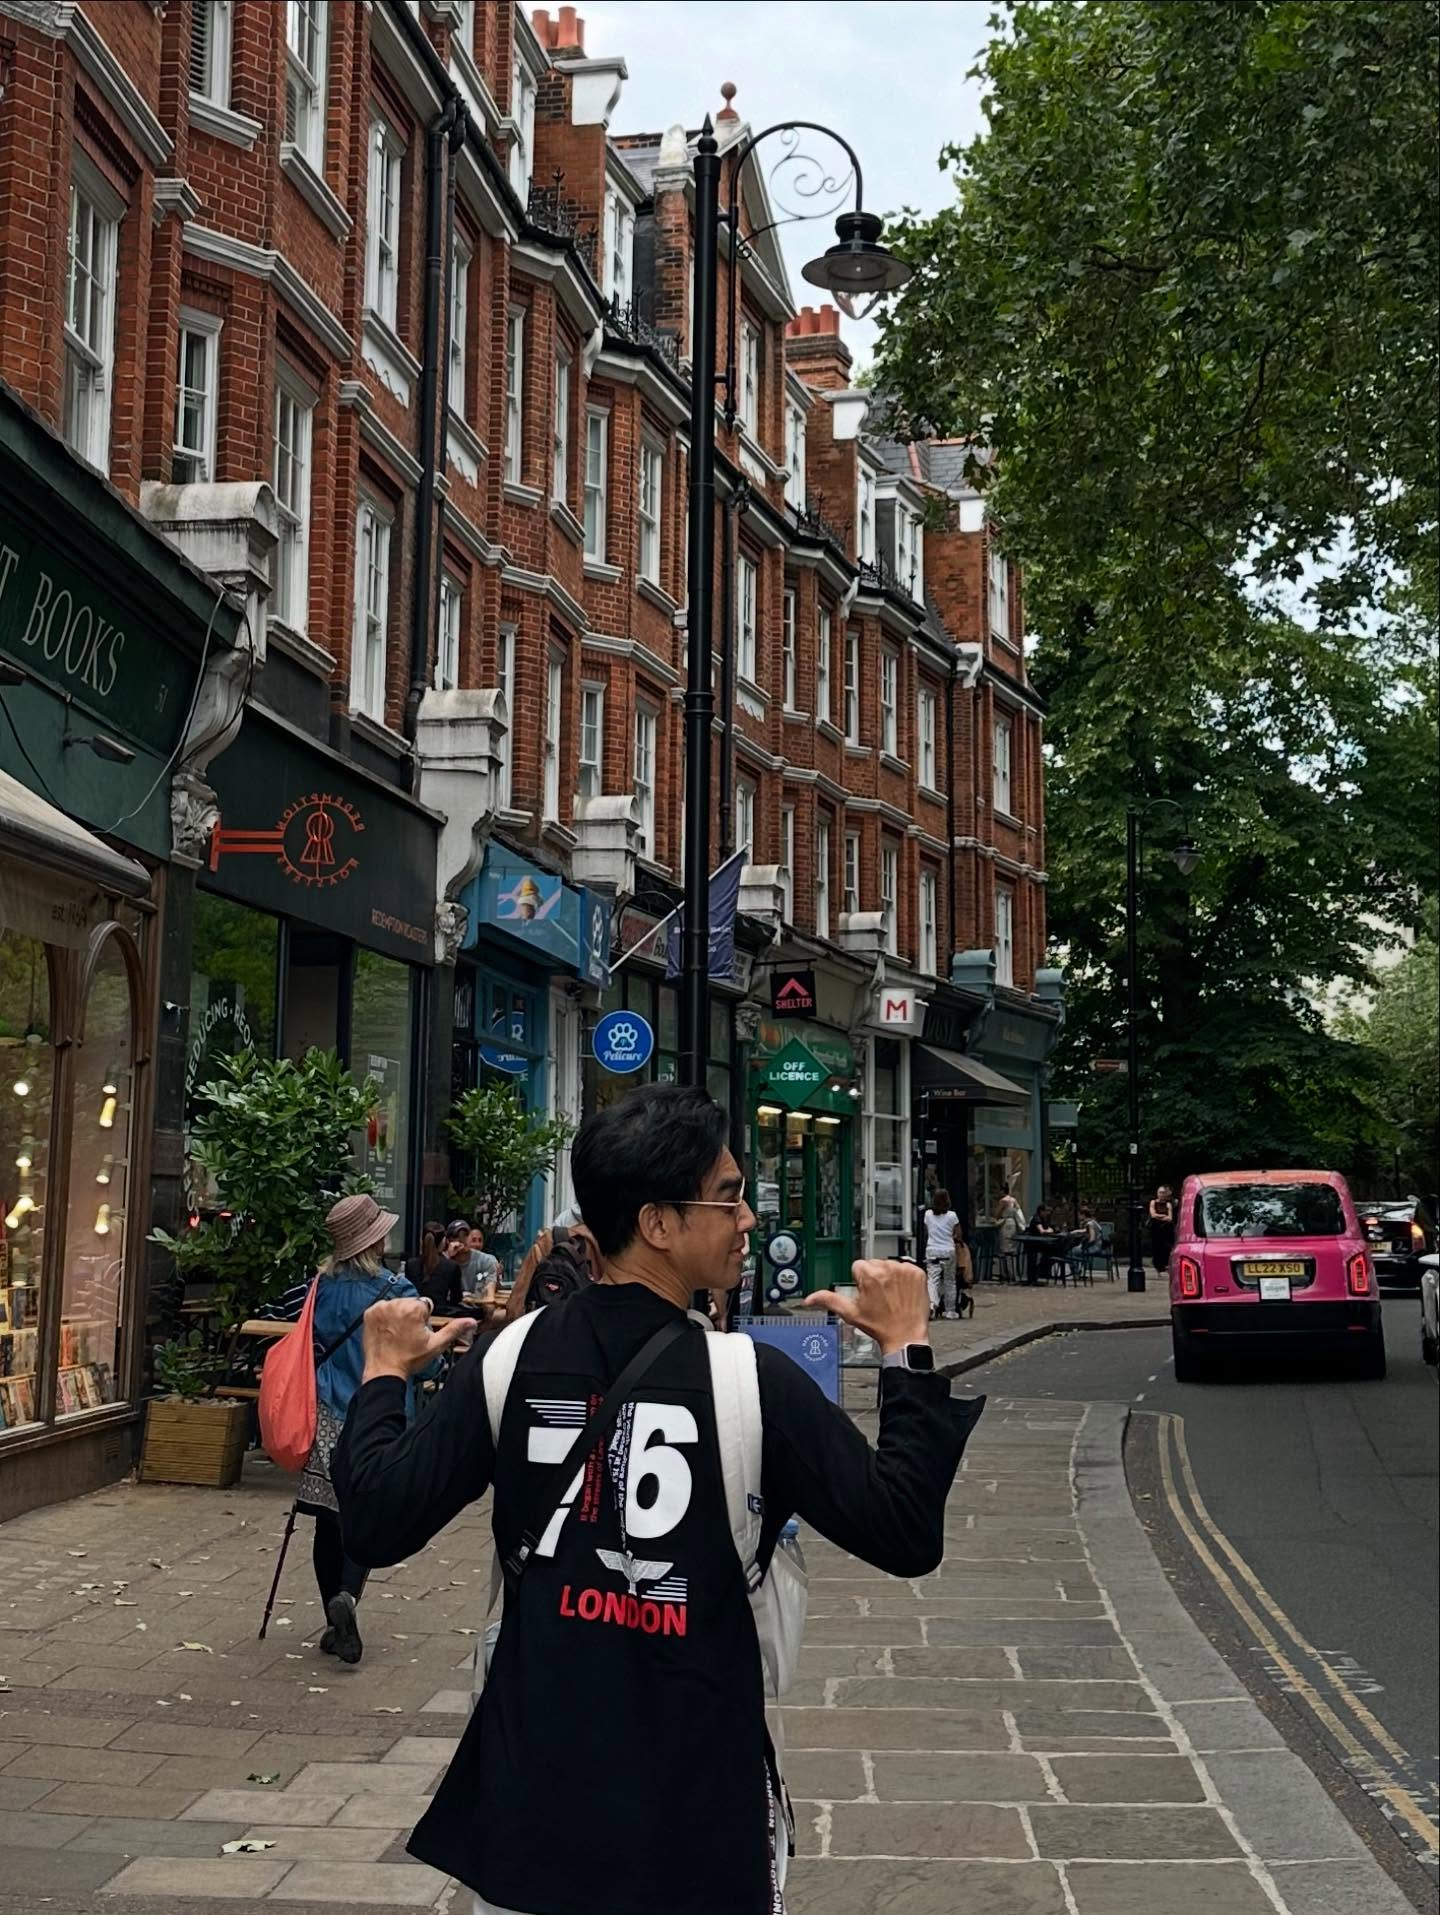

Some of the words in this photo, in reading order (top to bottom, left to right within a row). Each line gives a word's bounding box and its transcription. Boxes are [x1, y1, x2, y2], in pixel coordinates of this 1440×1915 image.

[21, 571, 126, 698] BOOKS
[775, 997, 813, 1010] SHELTER
[885, 998, 908, 1021] M
[185, 997, 228, 1095] REDUCING
[769, 1071, 819, 1081] LICENCE
[782, 1061, 806, 1071] OFF
[1247, 1263, 1276, 1274] LL22
[527, 1402, 699, 1558] 76
[560, 1584, 688, 1637] LONDON
[766, 1771, 776, 1829] LONDON
